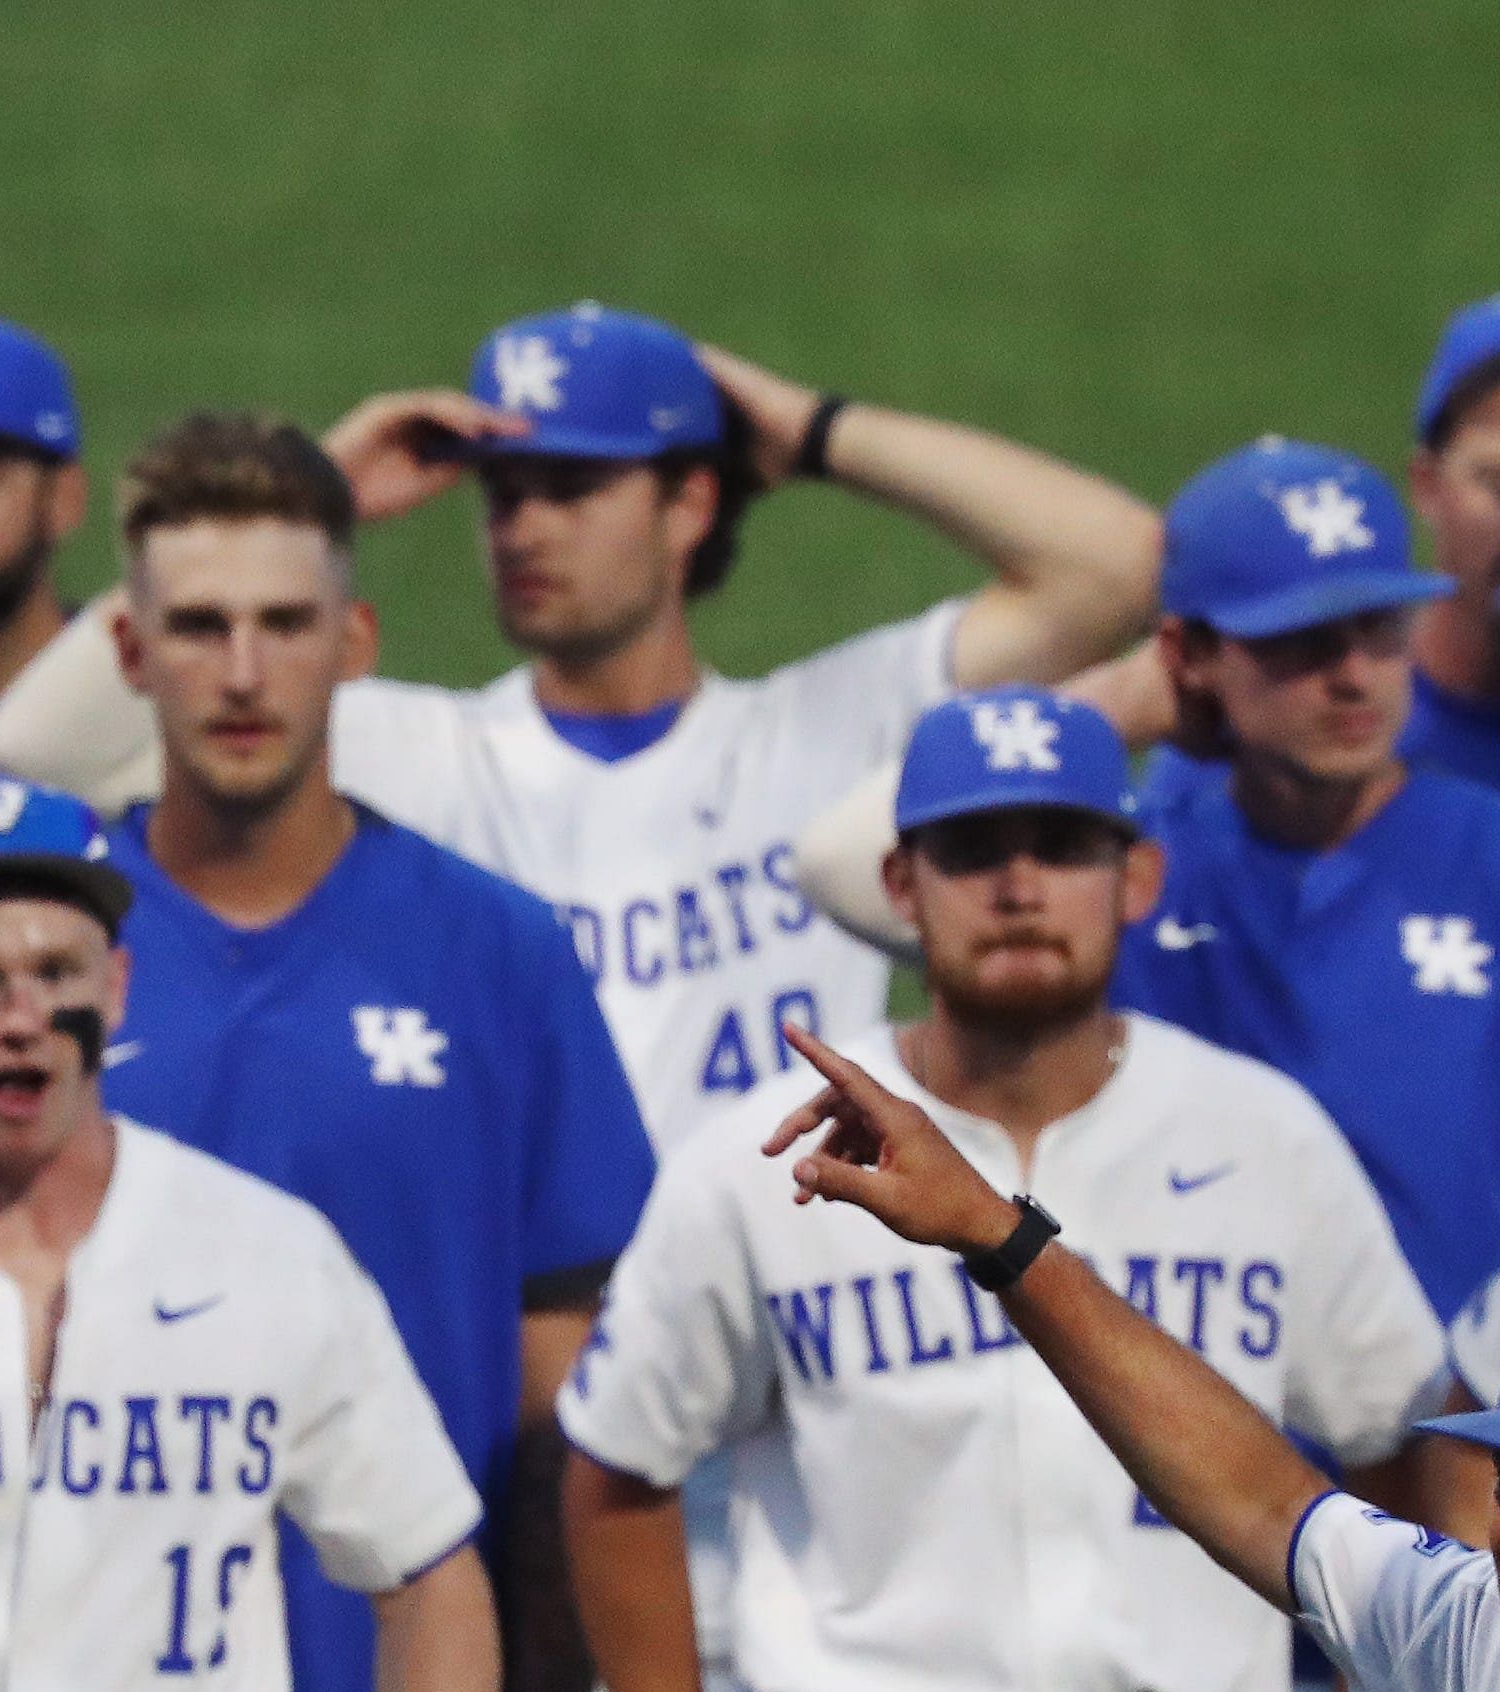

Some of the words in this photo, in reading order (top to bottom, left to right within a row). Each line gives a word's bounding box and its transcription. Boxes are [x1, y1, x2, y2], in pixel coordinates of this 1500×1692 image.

[494, 337, 566, 411] UK
[1280, 480, 1376, 557] UK
[974, 701, 1061, 771] UK
[1400, 916, 1493, 995] UK
[353, 1006, 449, 1088] UK
